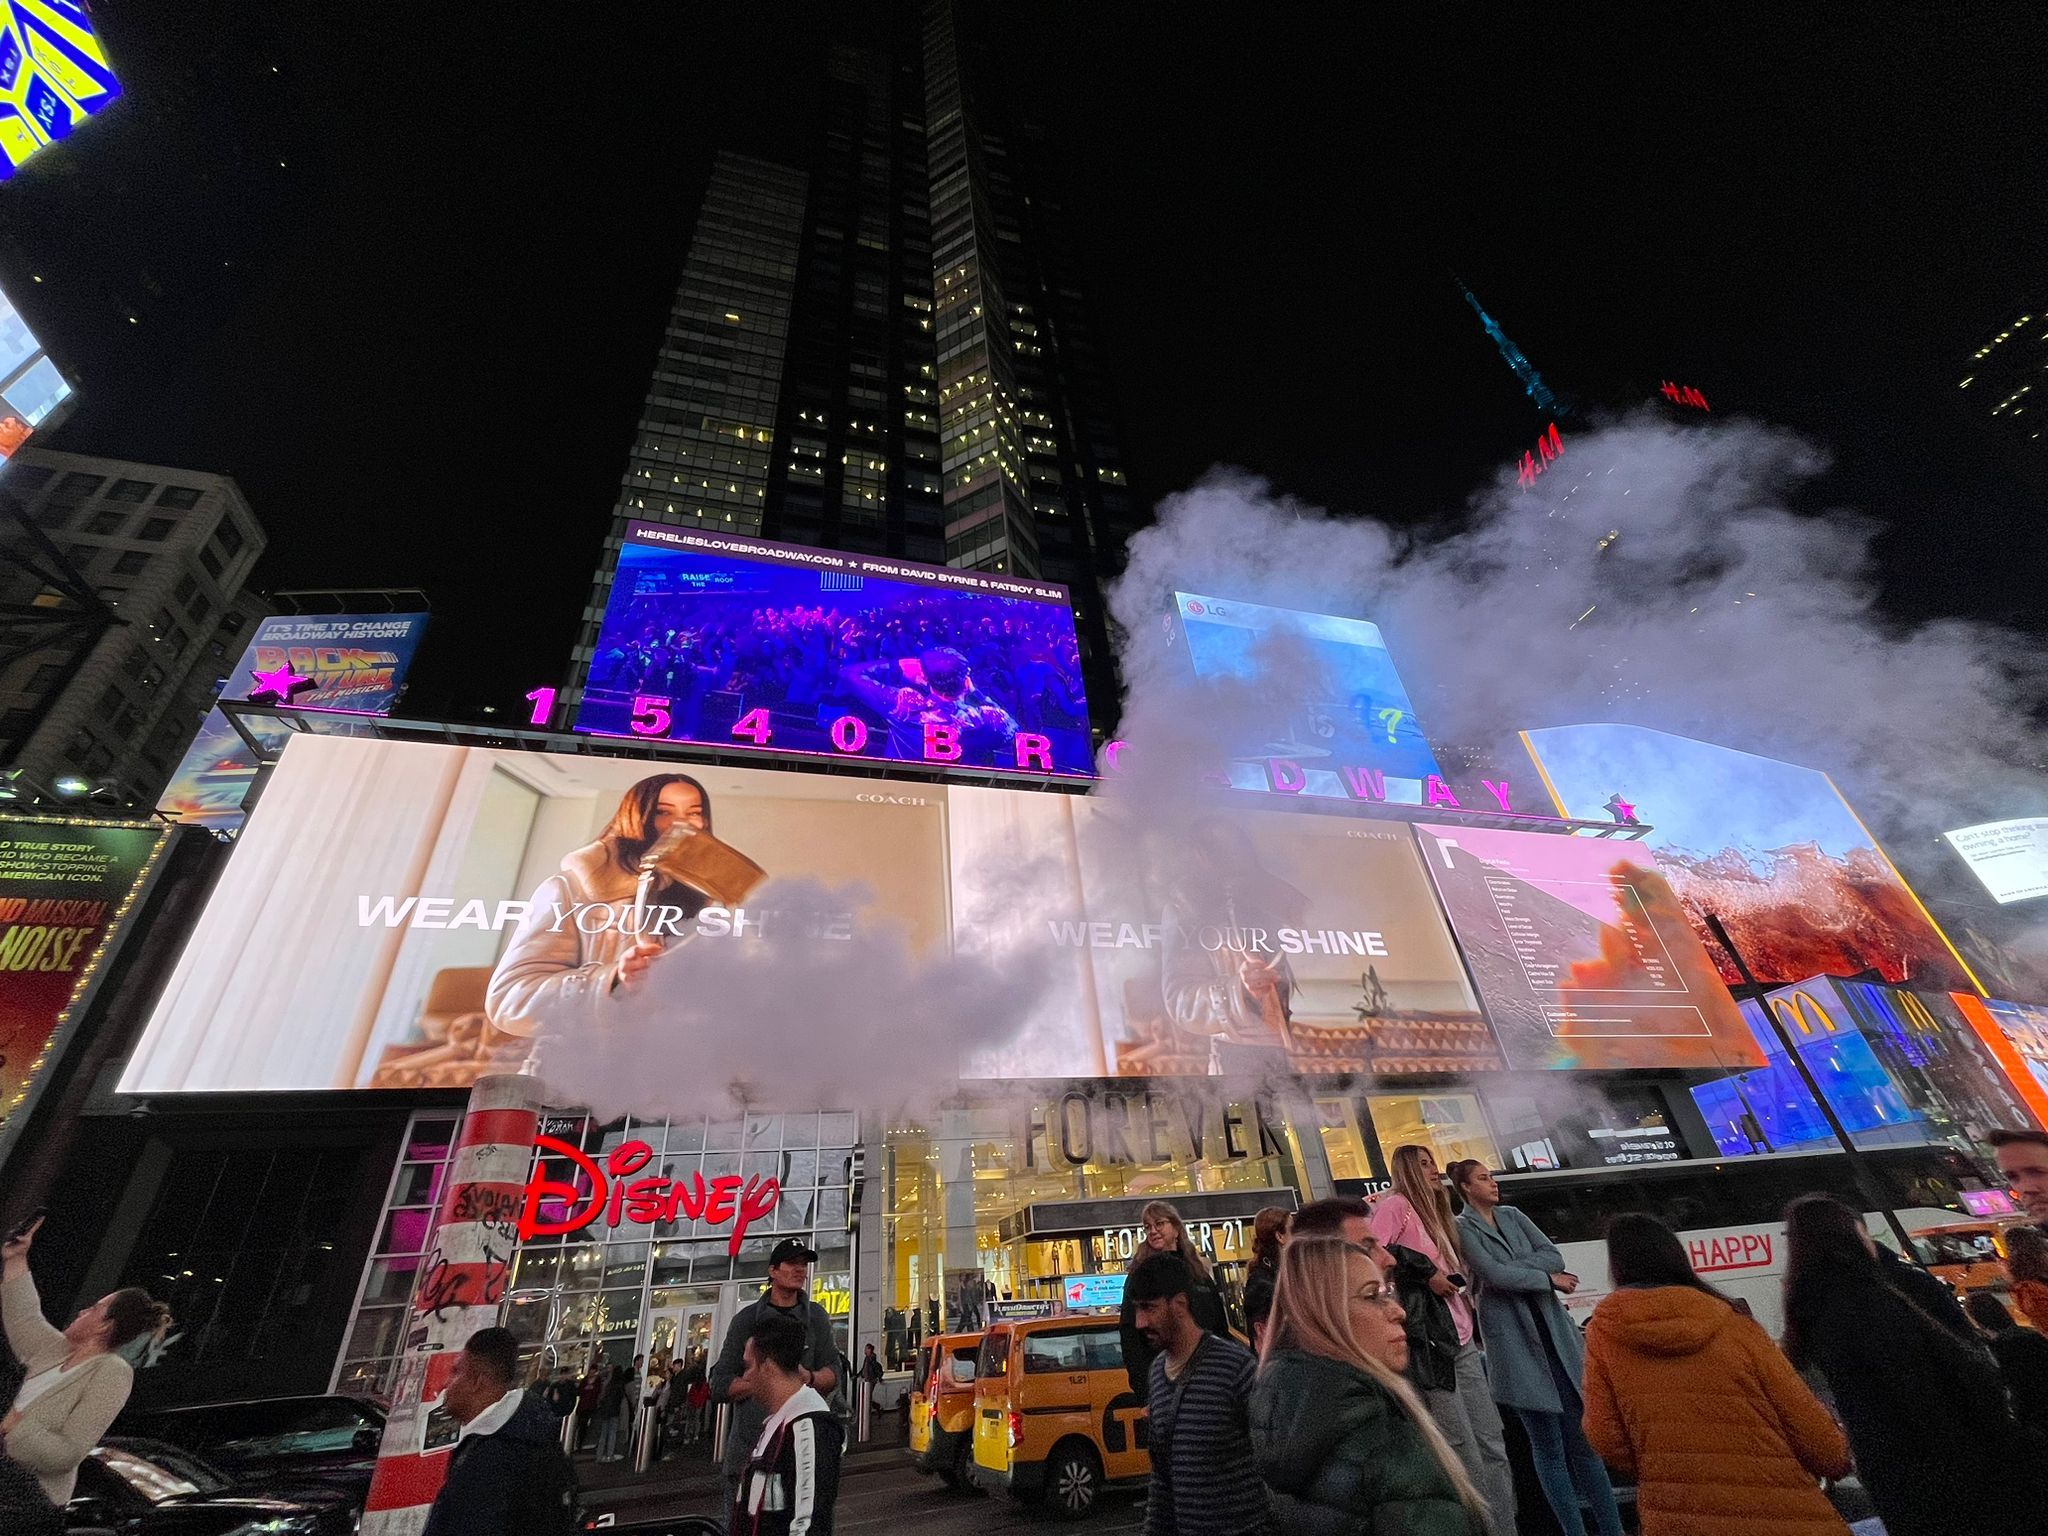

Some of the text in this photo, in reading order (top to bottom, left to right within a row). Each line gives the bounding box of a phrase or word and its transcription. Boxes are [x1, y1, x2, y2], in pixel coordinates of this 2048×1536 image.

[1516, 422, 1565, 494] H&M
[636, 528, 843, 567] HERELIESLOVEBROADWAY.COM
[862, 562, 1062, 599] FROM DAVID BYRNE & FATBOY SLIM
[1206, 604, 1227, 617] LG
[261, 630, 408, 641] BROADWAY HISTORY!
[265, 621, 412, 633] IT'S TIME TO CHANGE
[255, 647, 399, 673] BACK
[334, 684, 386, 698] MUSICAL
[855, 793, 926, 806] COACH
[14, 841, 50, 850] TRUE
[50, 842, 96, 852] STORY
[1346, 830, 1398, 841] COACH
[19, 852, 52, 860] WHO
[53, 853, 110, 863] BECAME
[66, 873, 103, 882] ICON.
[357, 895, 852, 940] WEAR YOUR SHE
[0, 925, 95, 972] NOISE
[1175, 926, 1275, 953] YOUR
[1277, 929, 1389, 957] SHINE
[1015, 1090, 1284, 1170] FOREVER
[1222, 1219, 1244, 1251] 21
[1688, 1233, 1773, 1272] HAPPY
